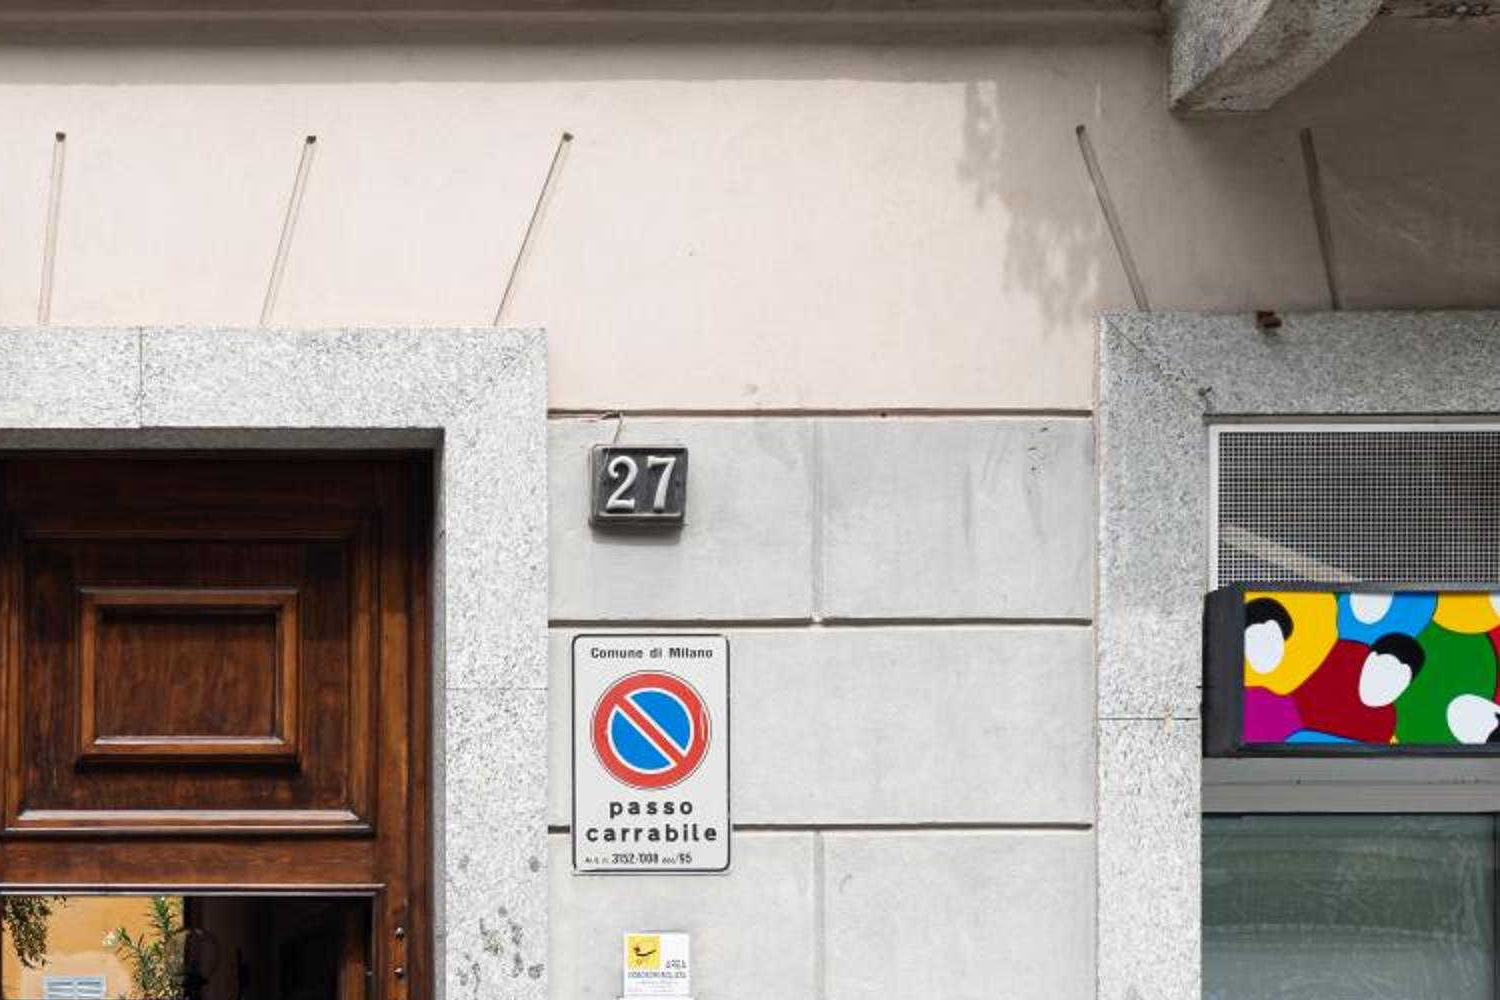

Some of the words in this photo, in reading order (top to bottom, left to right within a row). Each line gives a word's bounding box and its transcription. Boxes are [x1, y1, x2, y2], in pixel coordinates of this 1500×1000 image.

[605, 454, 677, 510] 27
[590, 647, 644, 659] Comune
[649, 647, 663, 659] di
[669, 647, 714, 659] Milano
[609, 800, 693, 819] passo
[585, 823, 717, 842] carrabile
